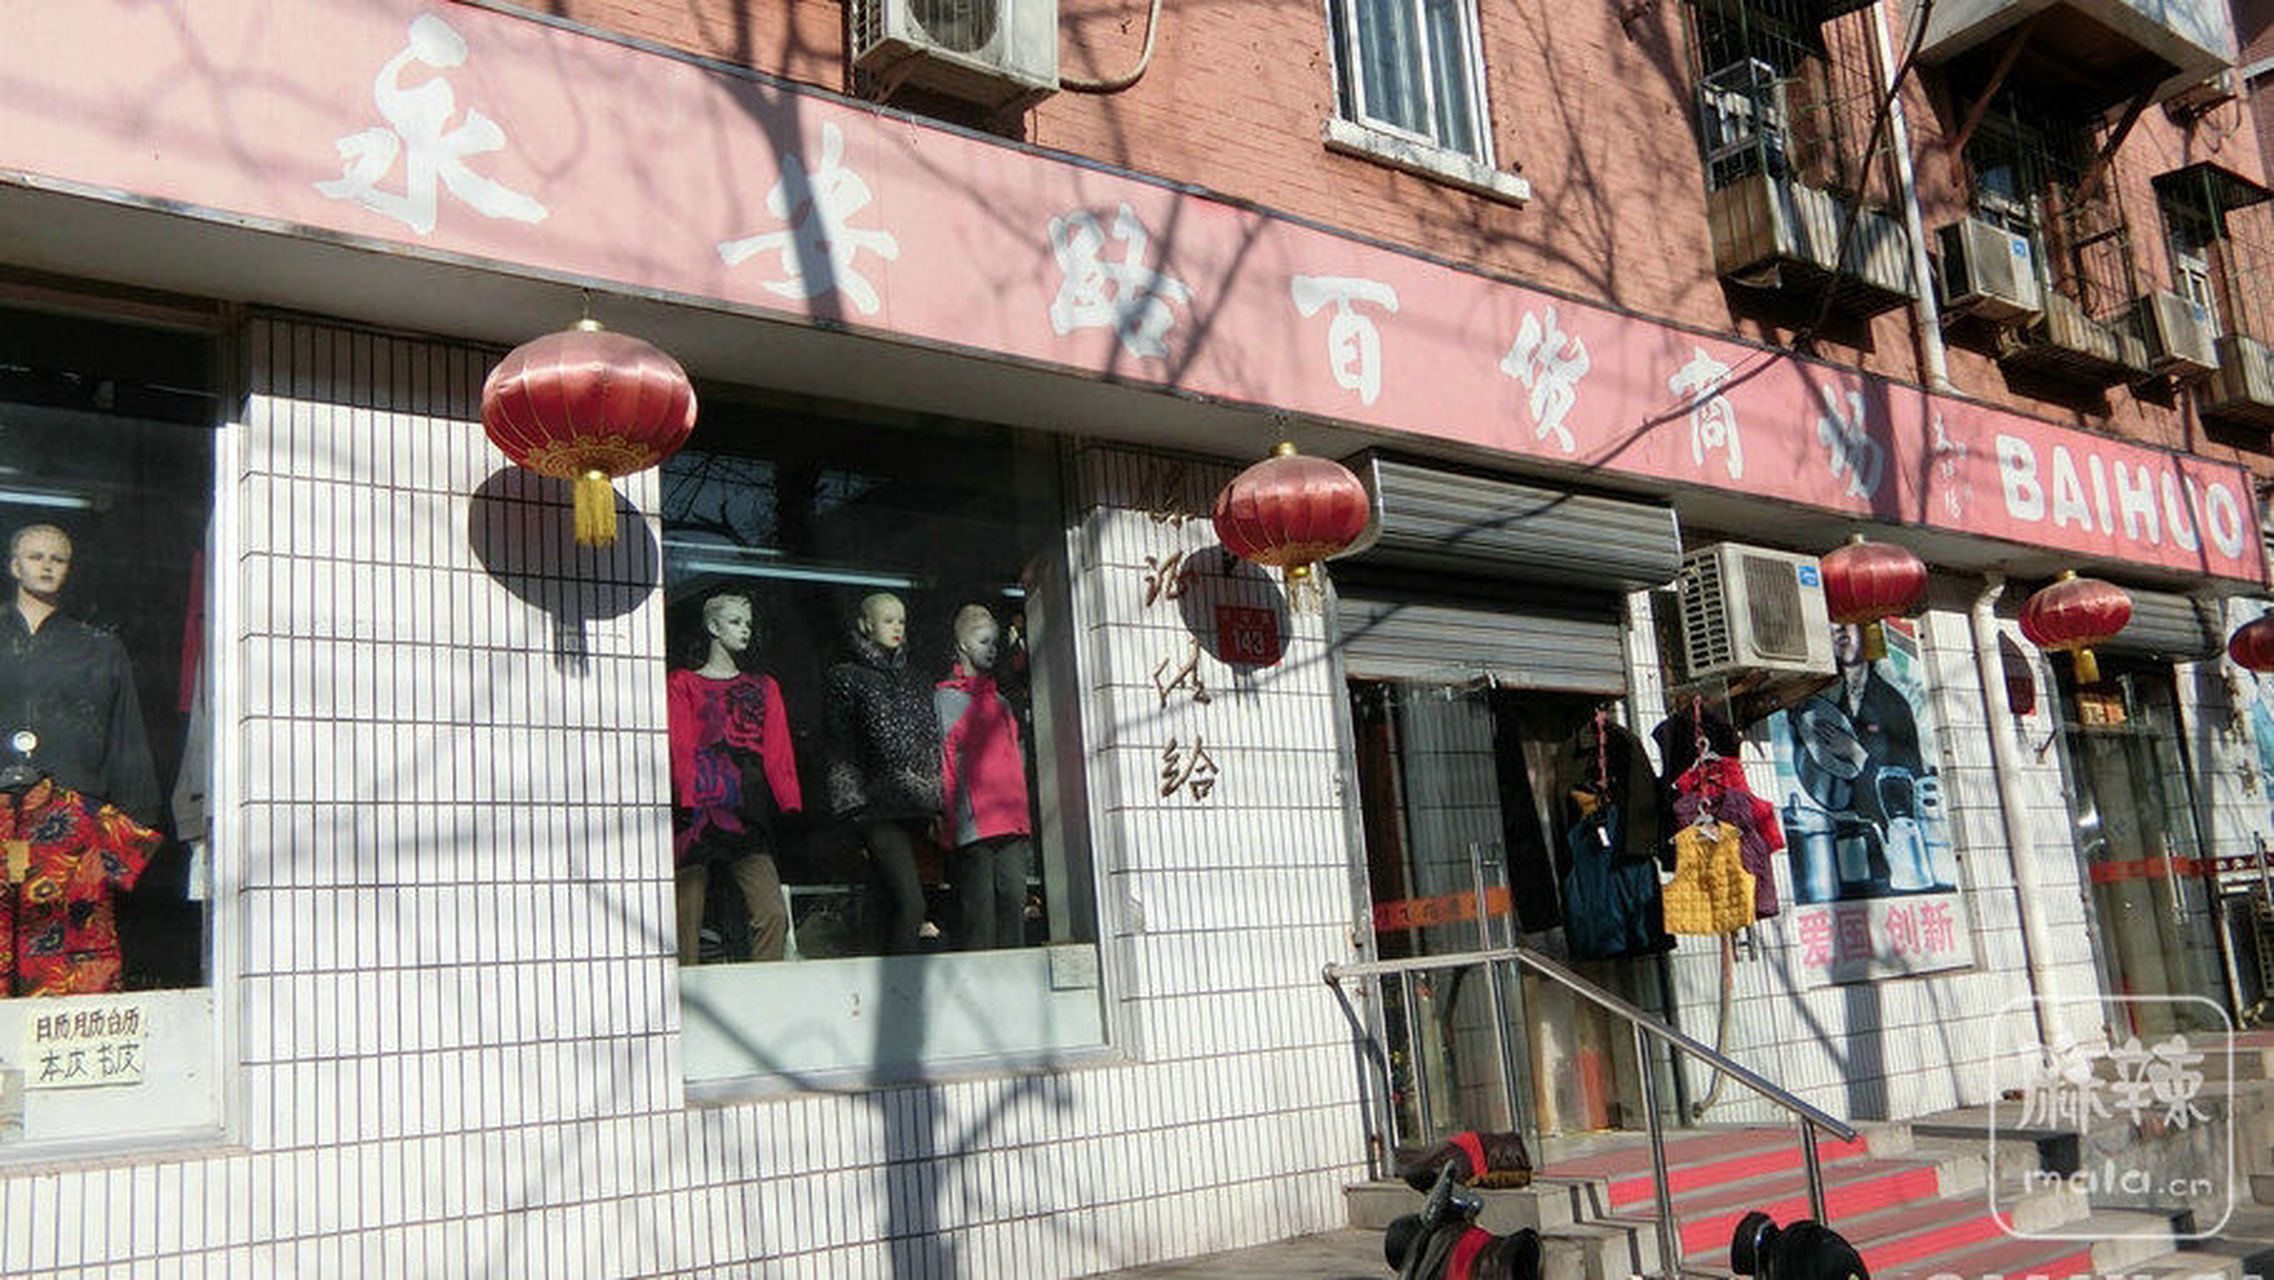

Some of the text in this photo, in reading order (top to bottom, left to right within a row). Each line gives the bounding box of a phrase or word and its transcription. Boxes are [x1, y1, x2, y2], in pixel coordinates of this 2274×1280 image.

[312, 14, 1885, 500] 永安路百货商场
[1995, 433, 2245, 561] BAIHUO
[1233, 629, 1266, 656] 143
[1798, 900, 1955, 969] 爱国创新
